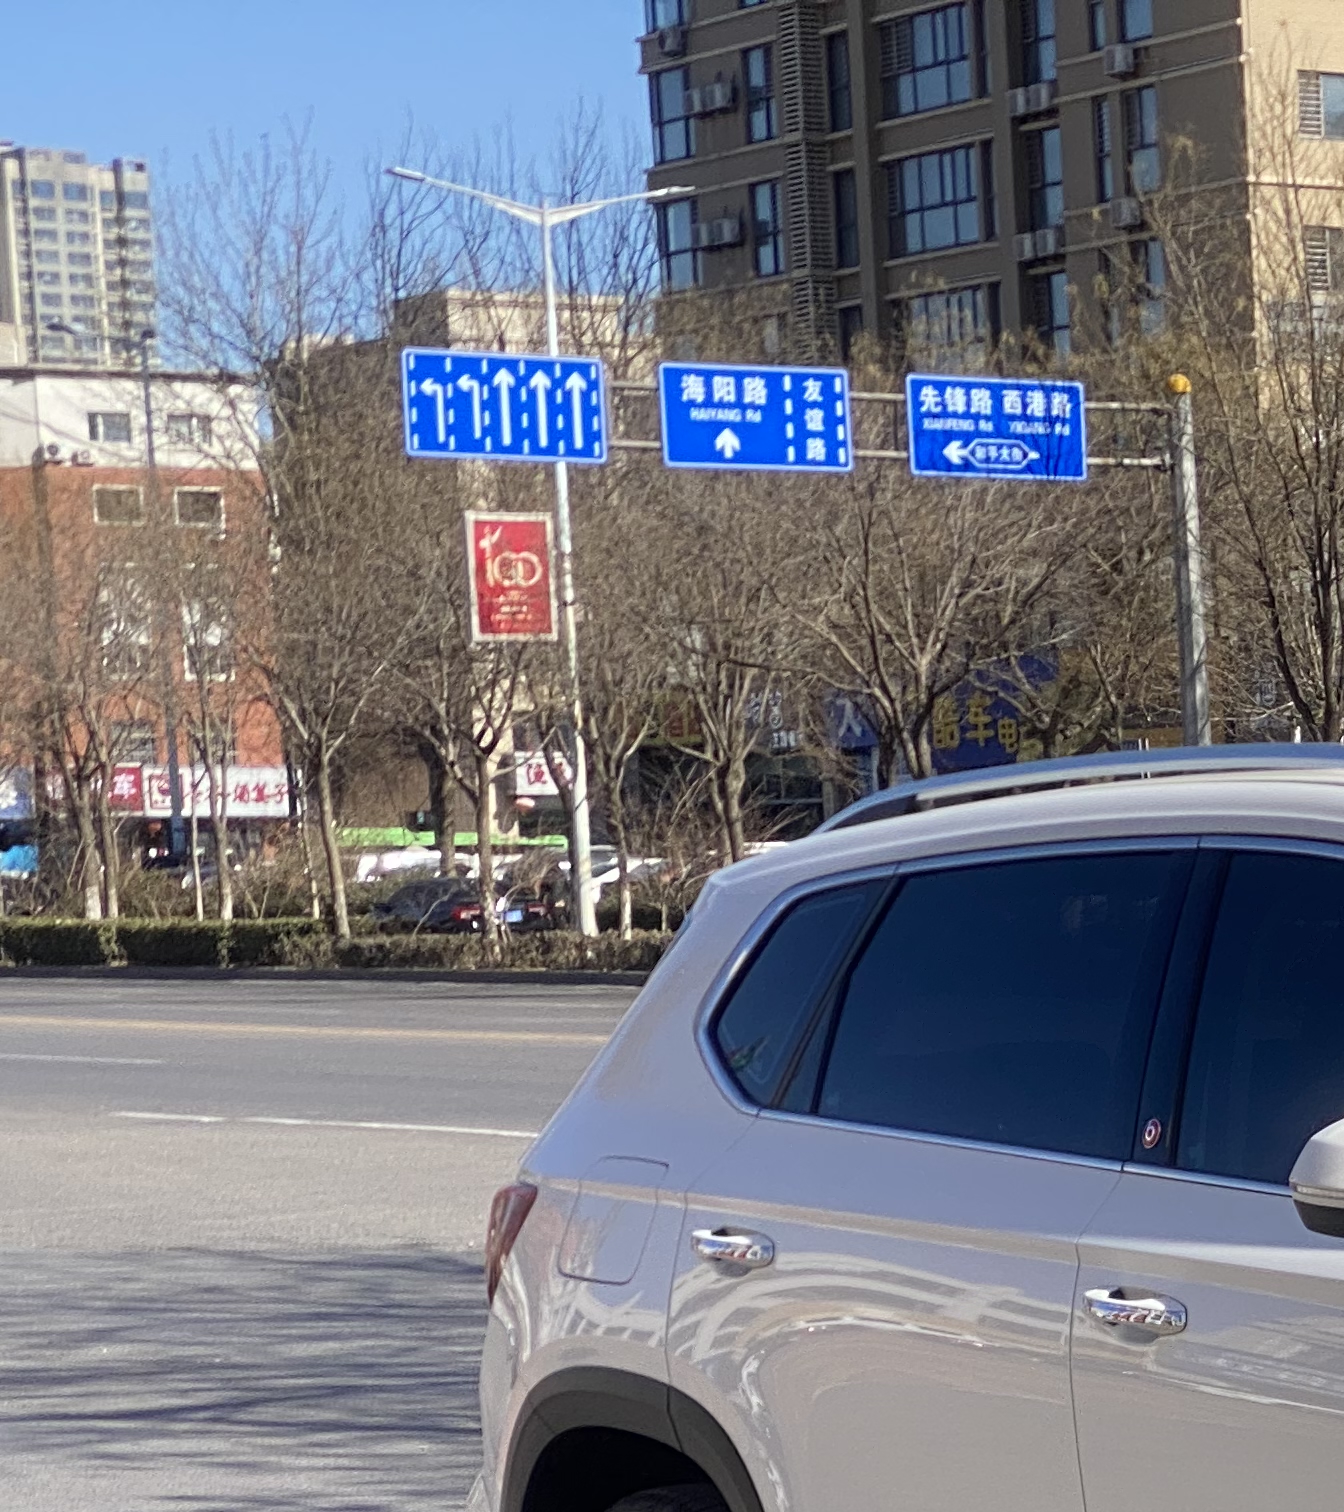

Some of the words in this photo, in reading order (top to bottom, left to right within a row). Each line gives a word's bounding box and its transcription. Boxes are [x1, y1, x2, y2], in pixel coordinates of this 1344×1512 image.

[680, 373, 768, 406] 海阳路
[919, 384, 993, 416] 先锋路
[689, 406, 742, 423] HAIYANG
[802, 377, 827, 462] 友谊路
